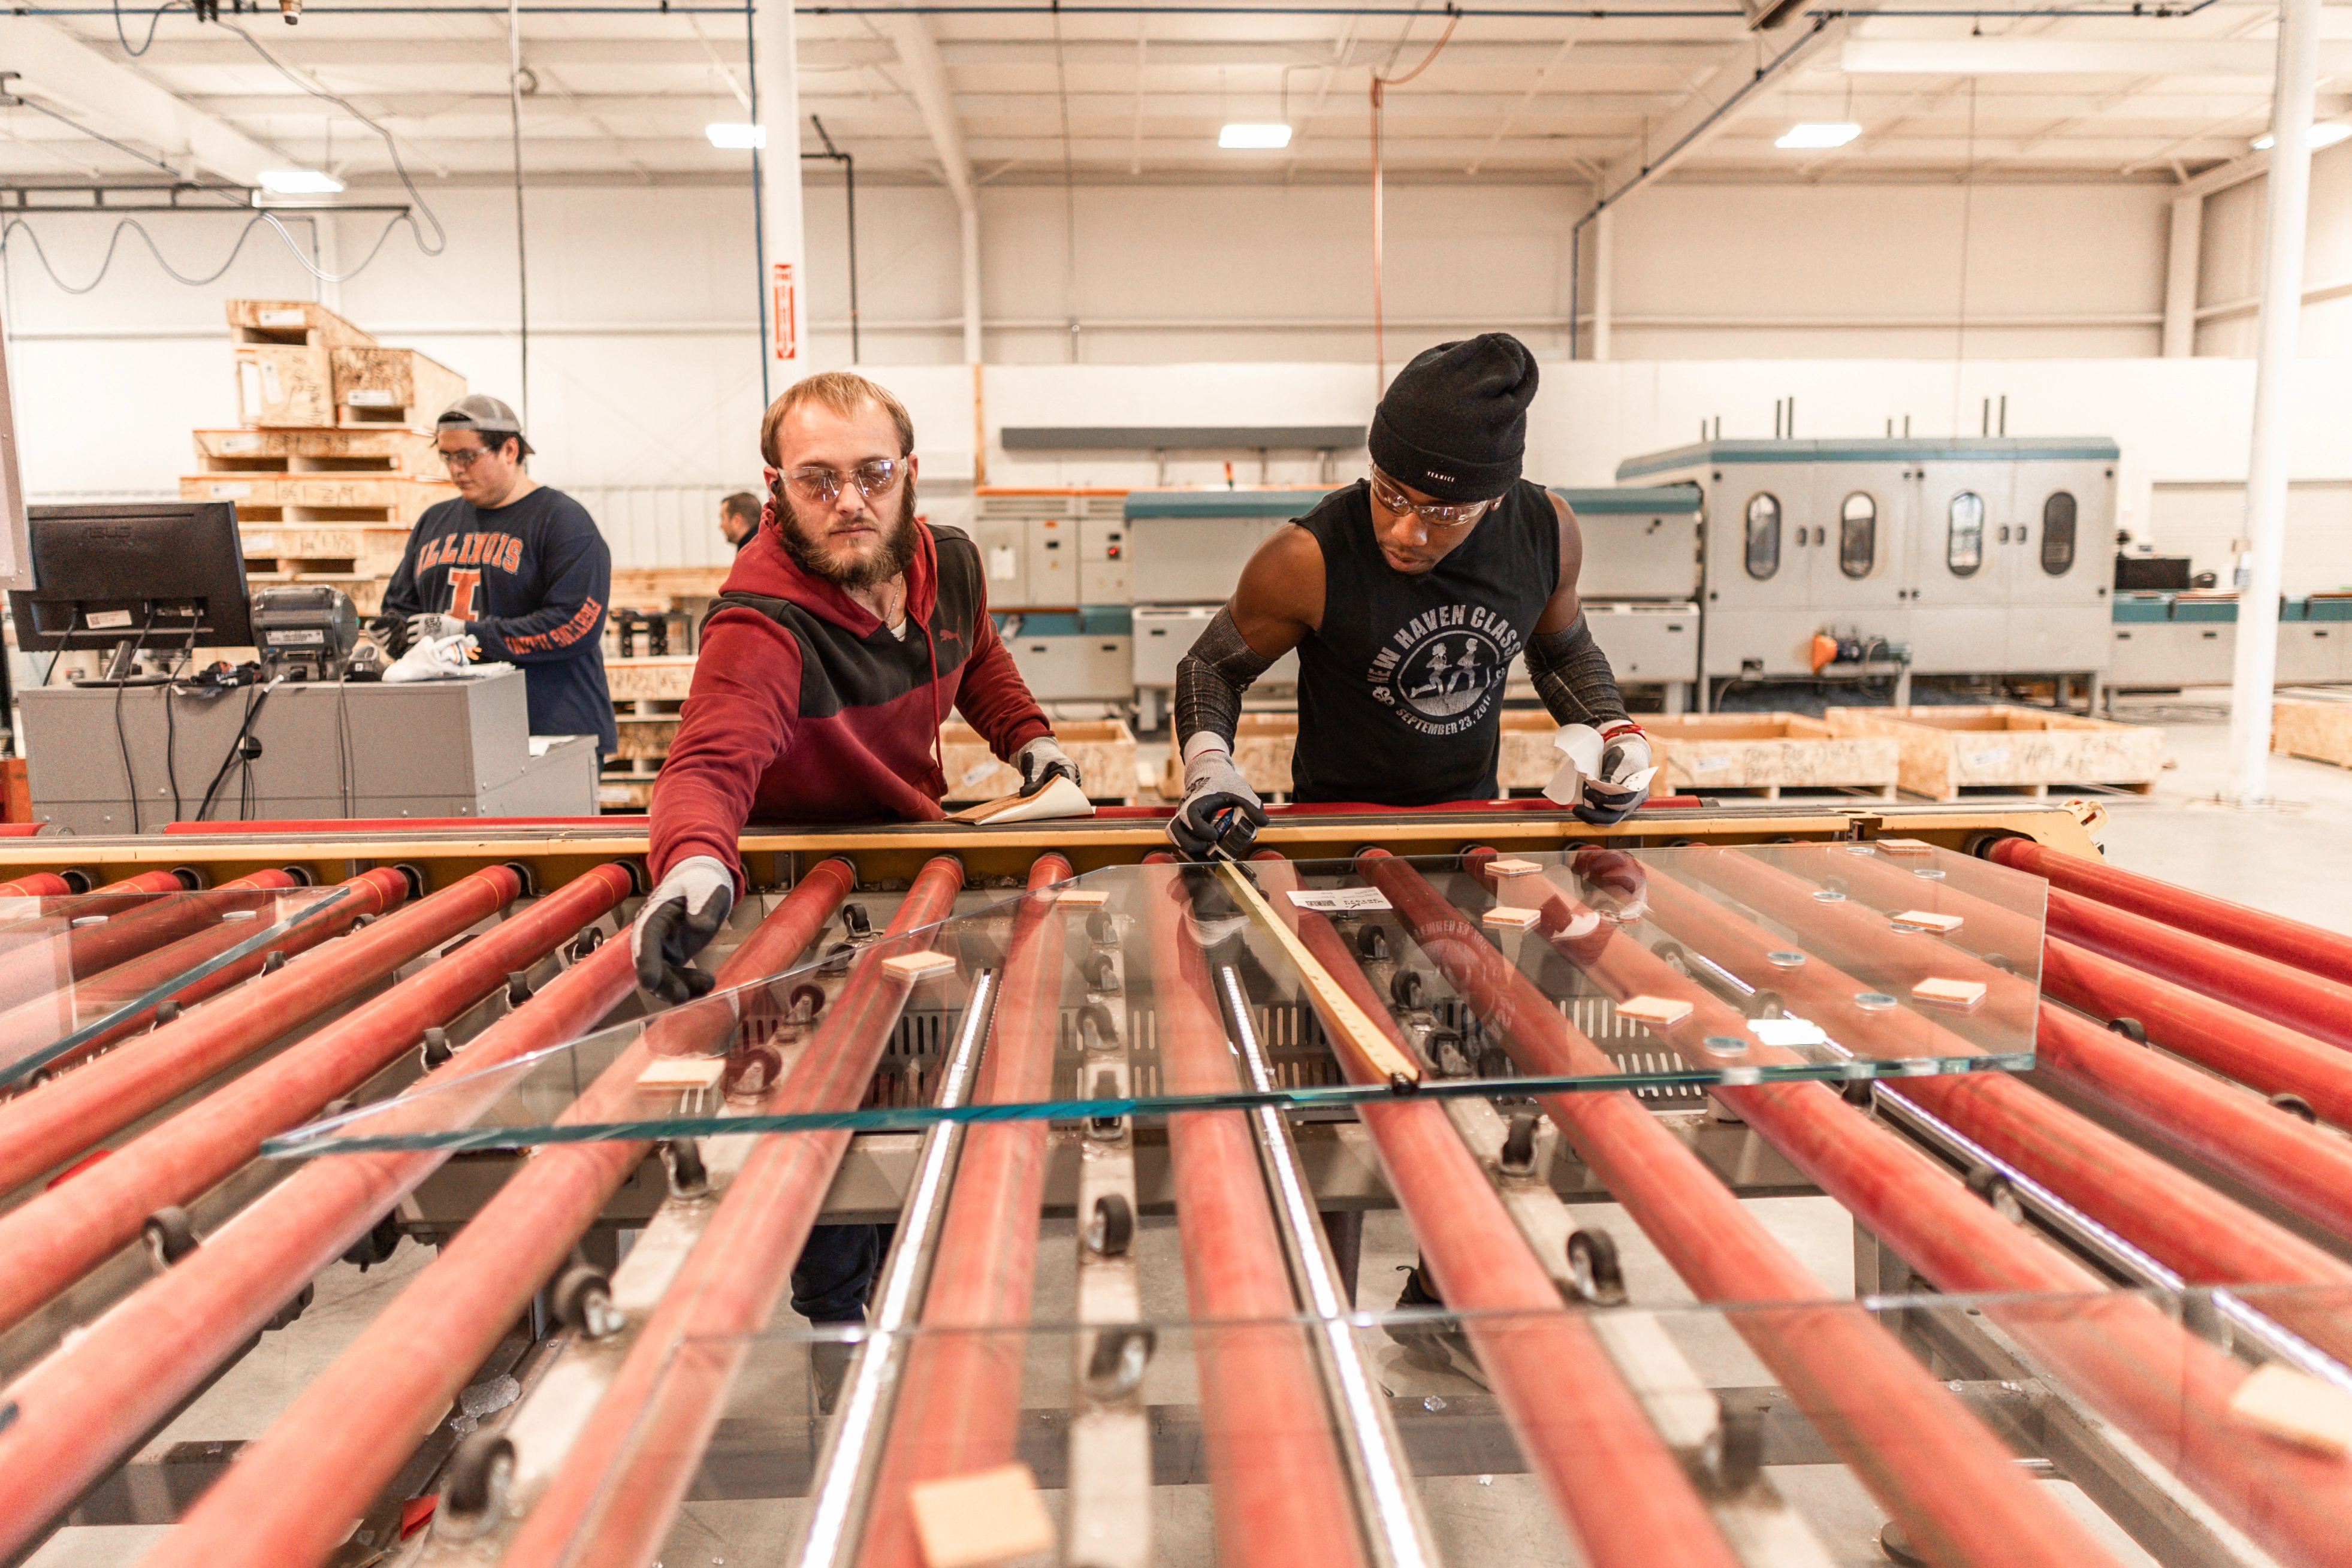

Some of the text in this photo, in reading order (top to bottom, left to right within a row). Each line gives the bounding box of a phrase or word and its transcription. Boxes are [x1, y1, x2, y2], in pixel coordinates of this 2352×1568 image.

[416, 531, 523, 576] ILLINOIS
[444, 568, 481, 622] I
[549, 596, 602, 648] FIGHTING
[1367, 605, 1521, 684] NEW HAVEN CLASS
[1396, 694, 1491, 735] SEPTEMBER 23, 2017
